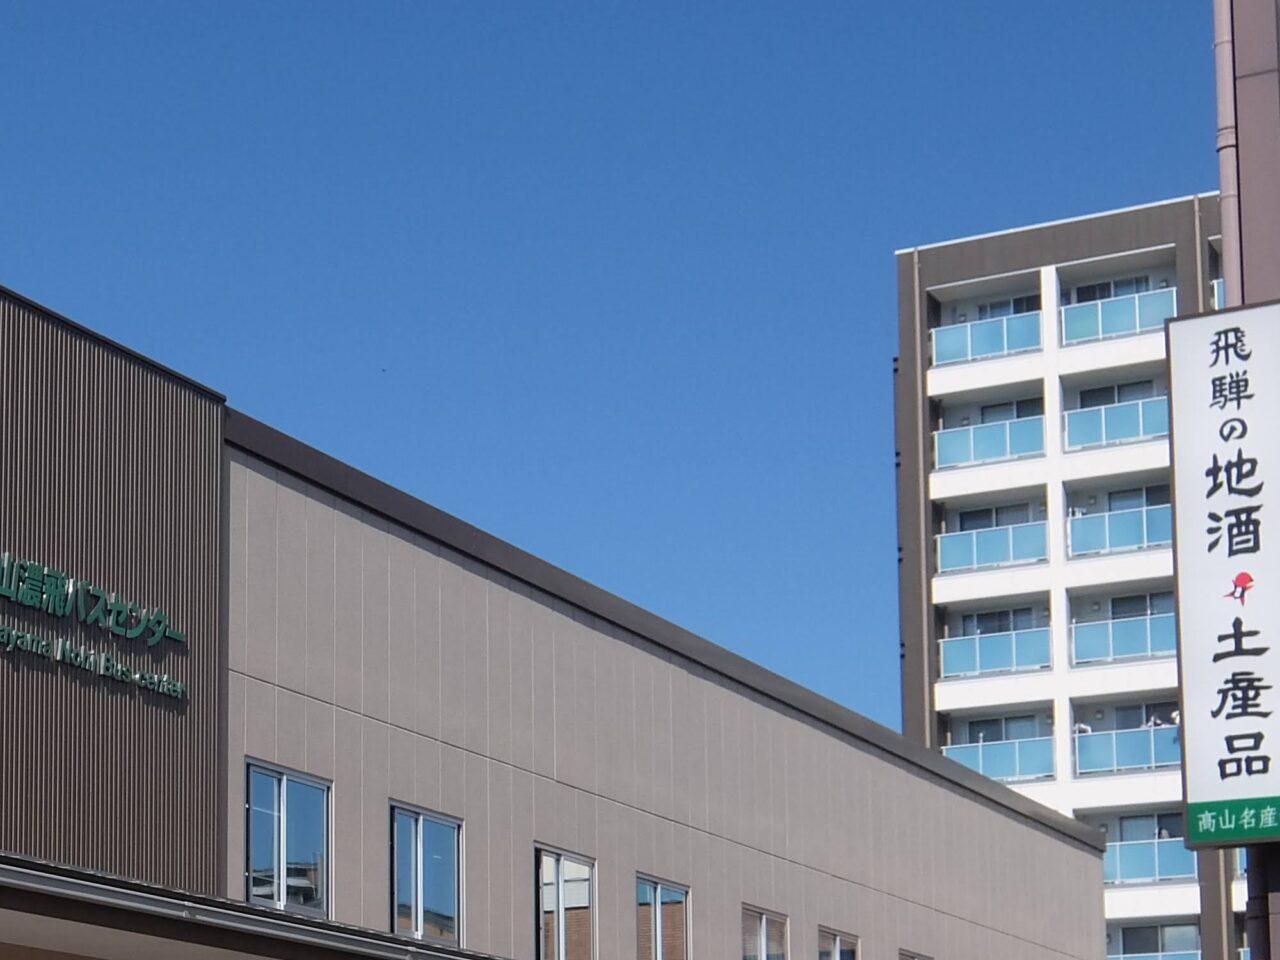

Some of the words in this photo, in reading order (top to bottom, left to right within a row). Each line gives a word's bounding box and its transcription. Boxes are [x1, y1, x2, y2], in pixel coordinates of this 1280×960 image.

[56, 638, 97, 671] Nohi
[100, 652, 132, 683] Bus
[1211, 616, 1273, 780] 土産品
